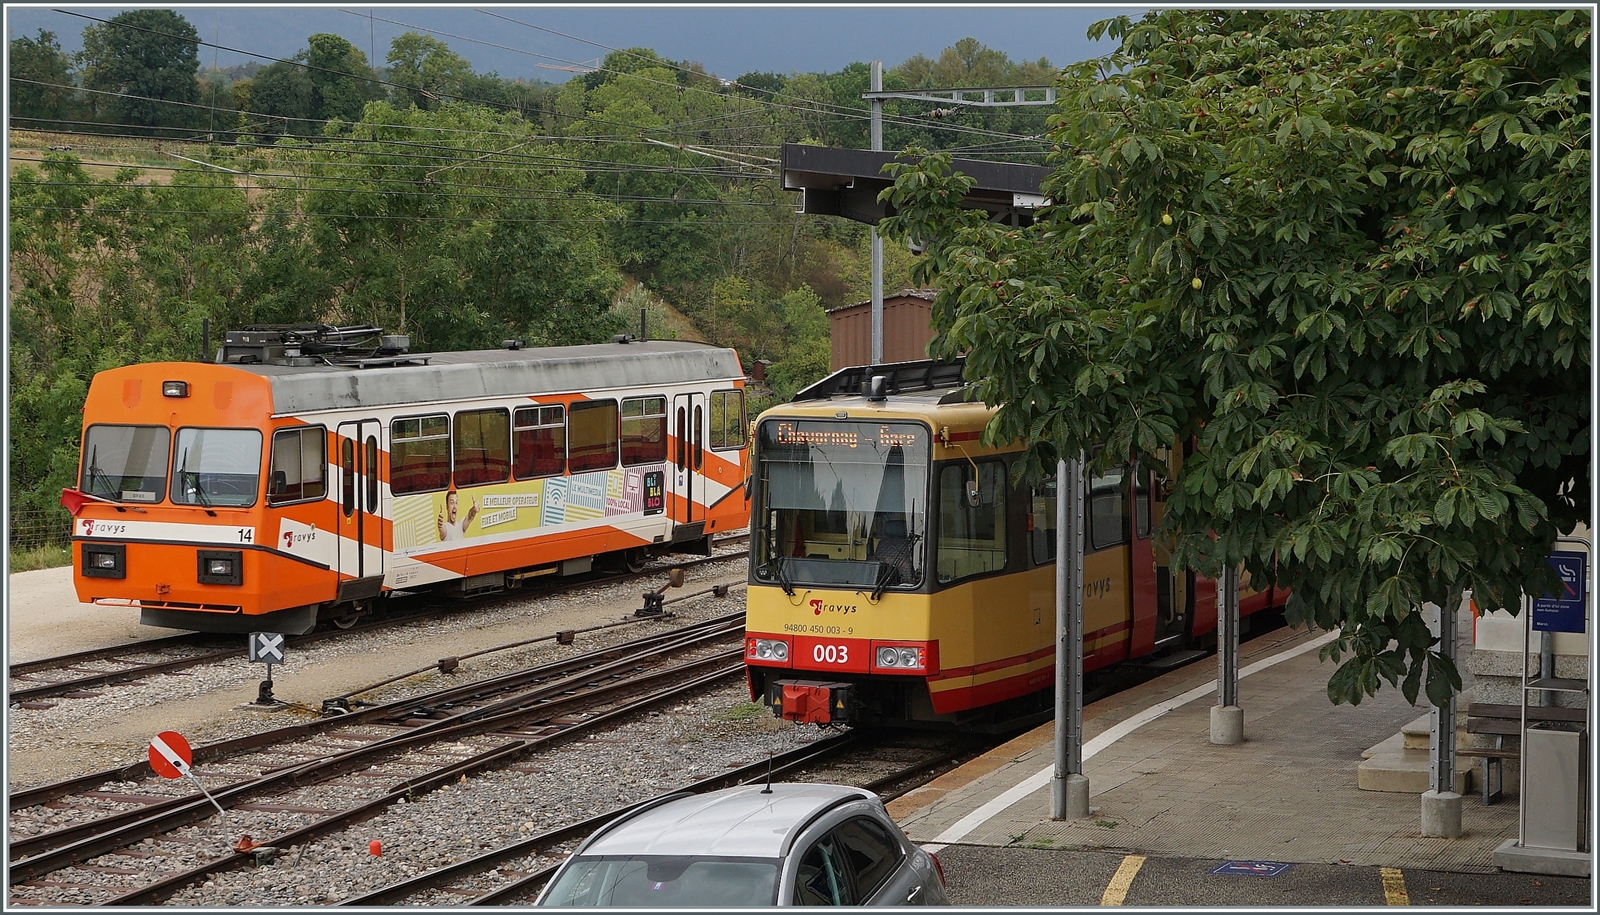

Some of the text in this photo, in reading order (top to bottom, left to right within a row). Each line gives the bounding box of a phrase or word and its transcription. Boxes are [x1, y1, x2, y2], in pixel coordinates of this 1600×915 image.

[650, 486, 660, 496] BLA
[484, 497, 489, 506] LE
[490, 497, 511, 506] MEILLEUR
[606, 497, 630, 509] 100% LOCAL
[648, 497, 660, 507] BLO
[482, 509, 515, 527] FIXE ET MOBILE
[238, 528, 252, 542] 14
[809, 599, 857, 615] travys
[784, 623, 807, 633] 94800
[810, 625, 824, 633] 450
[826, 625, 840, 634] 003
[848, 626, 853, 635] 9
[813, 644, 849, 664] 003
